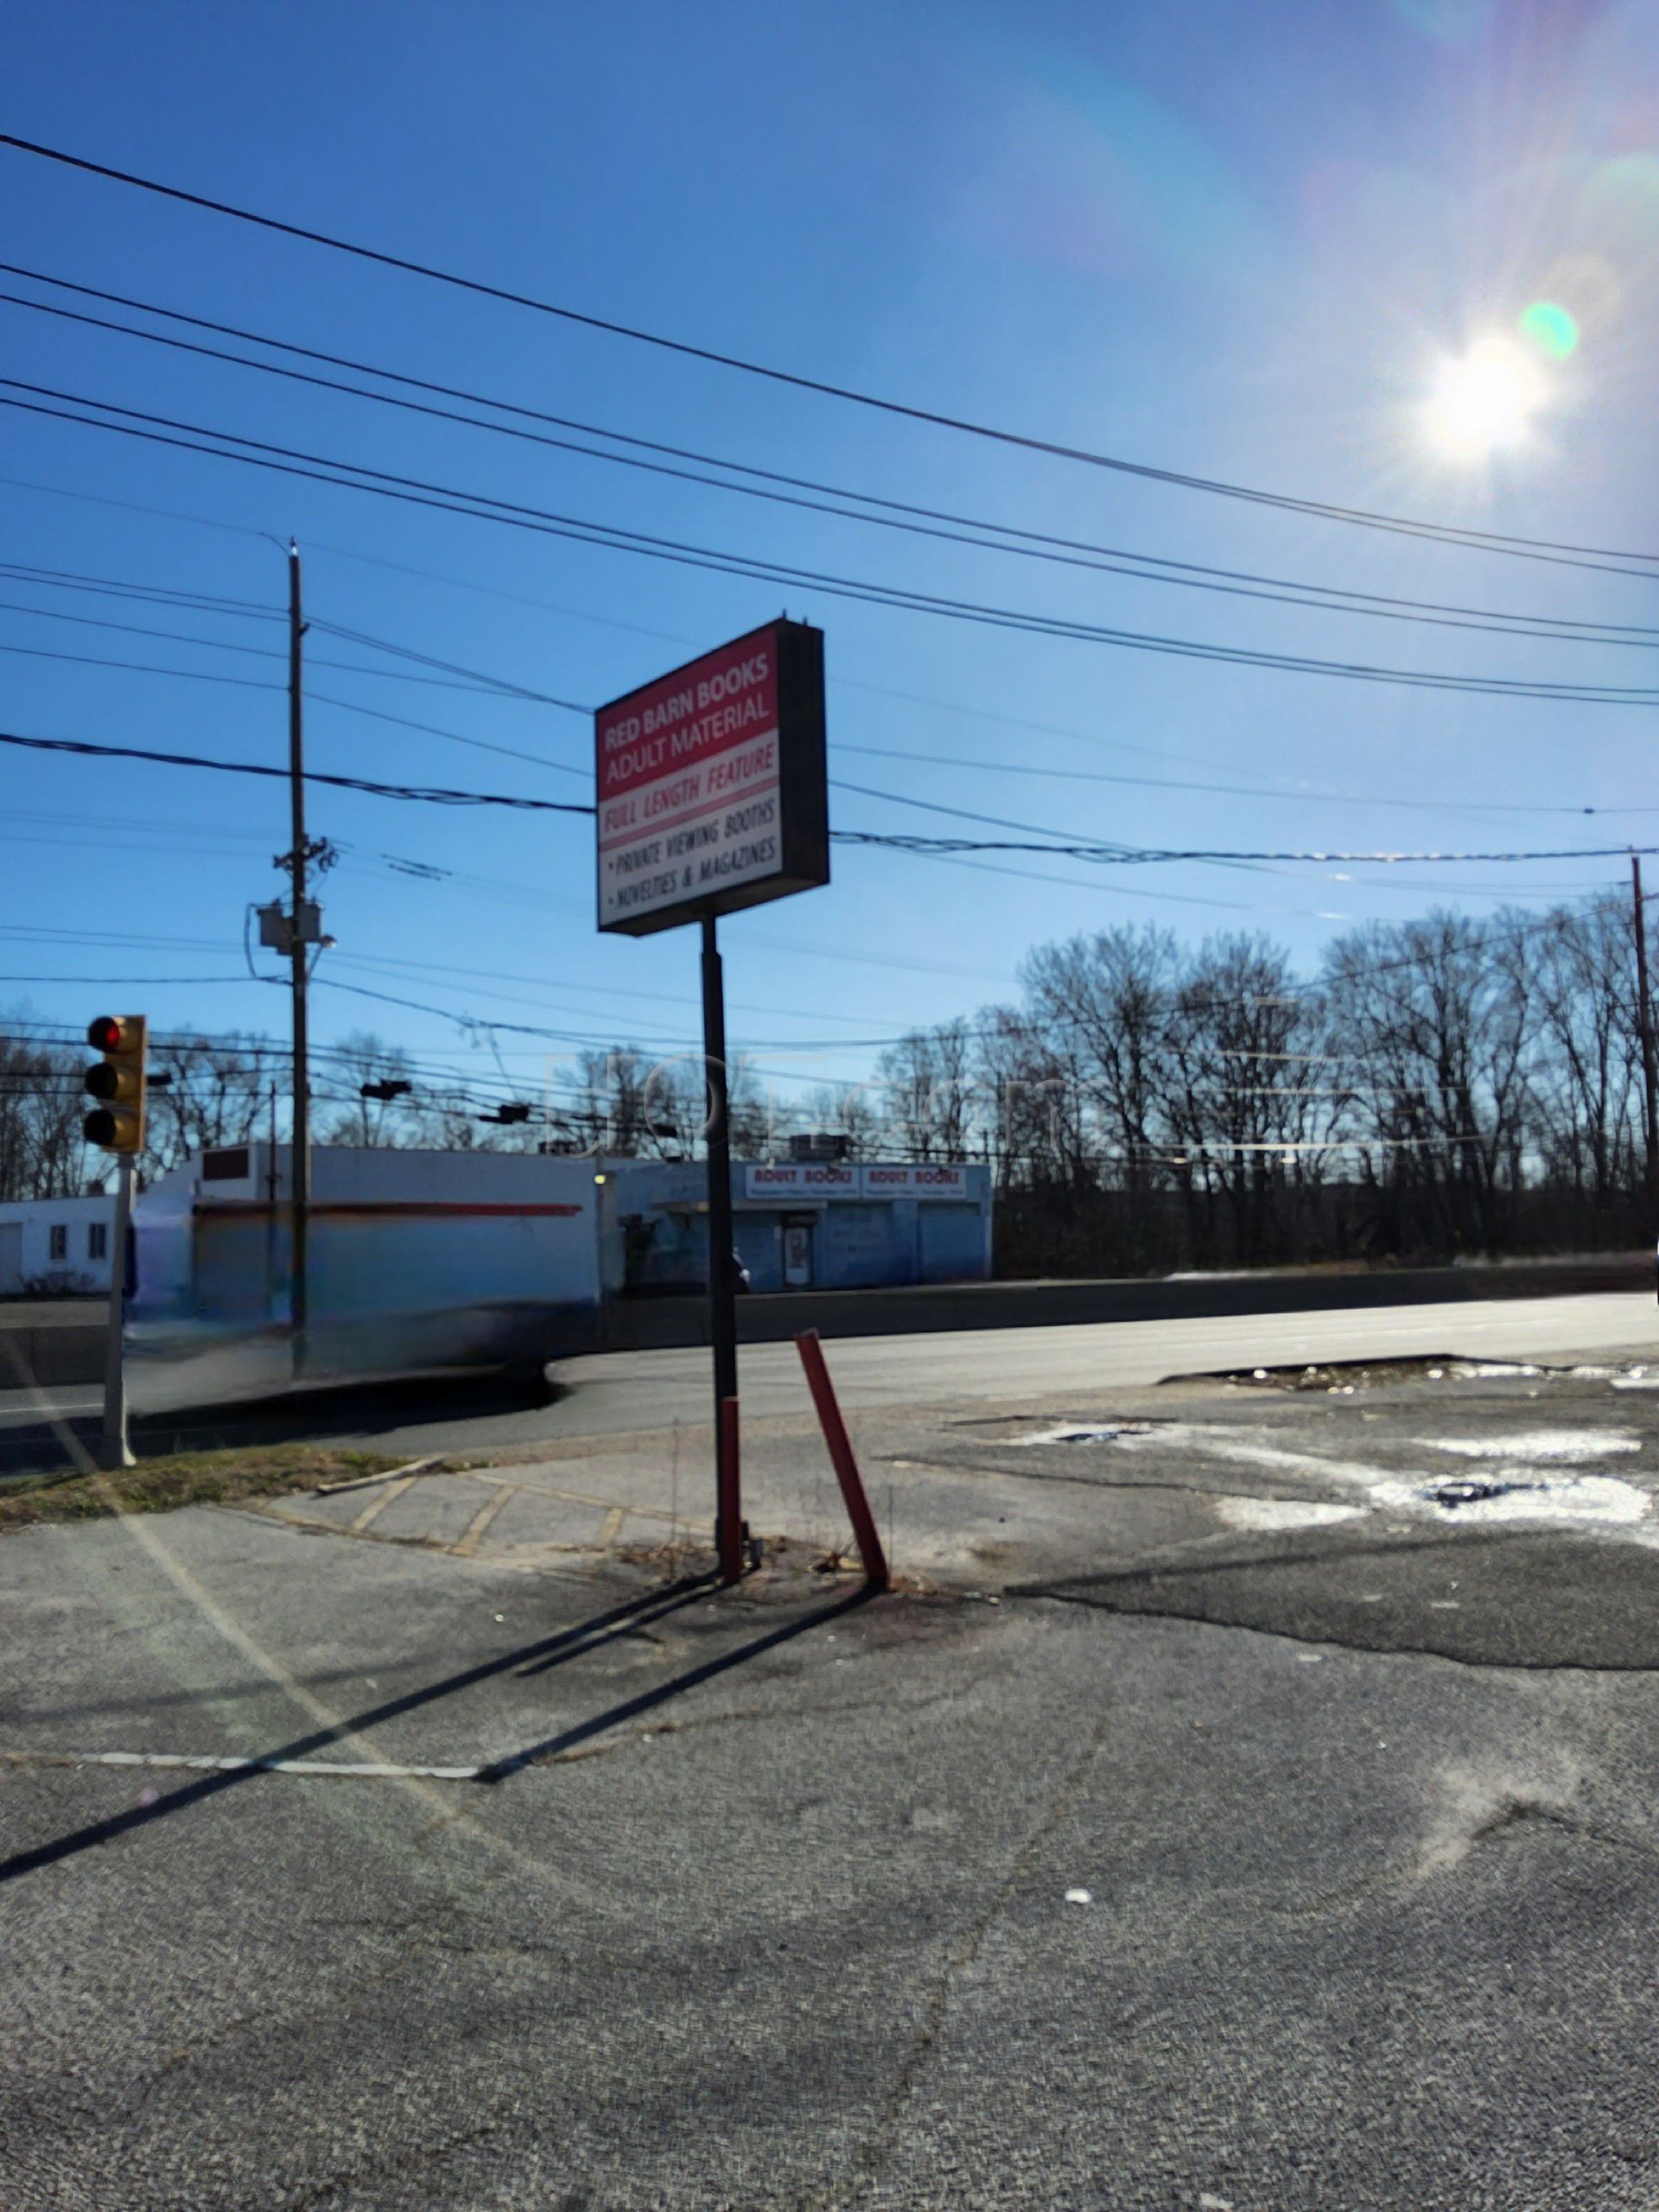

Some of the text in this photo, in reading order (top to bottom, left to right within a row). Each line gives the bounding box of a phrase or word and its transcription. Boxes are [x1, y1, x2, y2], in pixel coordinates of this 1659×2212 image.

[606, 653, 769, 752] RED BARN BOOKS
[606, 692, 770, 785] ADULT MATERIAL
[603, 742, 775, 834] FULL LENGTH FEATURE
[616, 798, 775, 875] PRIVATE VIEWING BOOTHS
[616, 870, 677, 908] NOVELTIES
[698, 836, 776, 882] MAGAZINES
[754, 1169, 797, 1184] ADULT
[869, 1170, 908, 1185] ADULT
